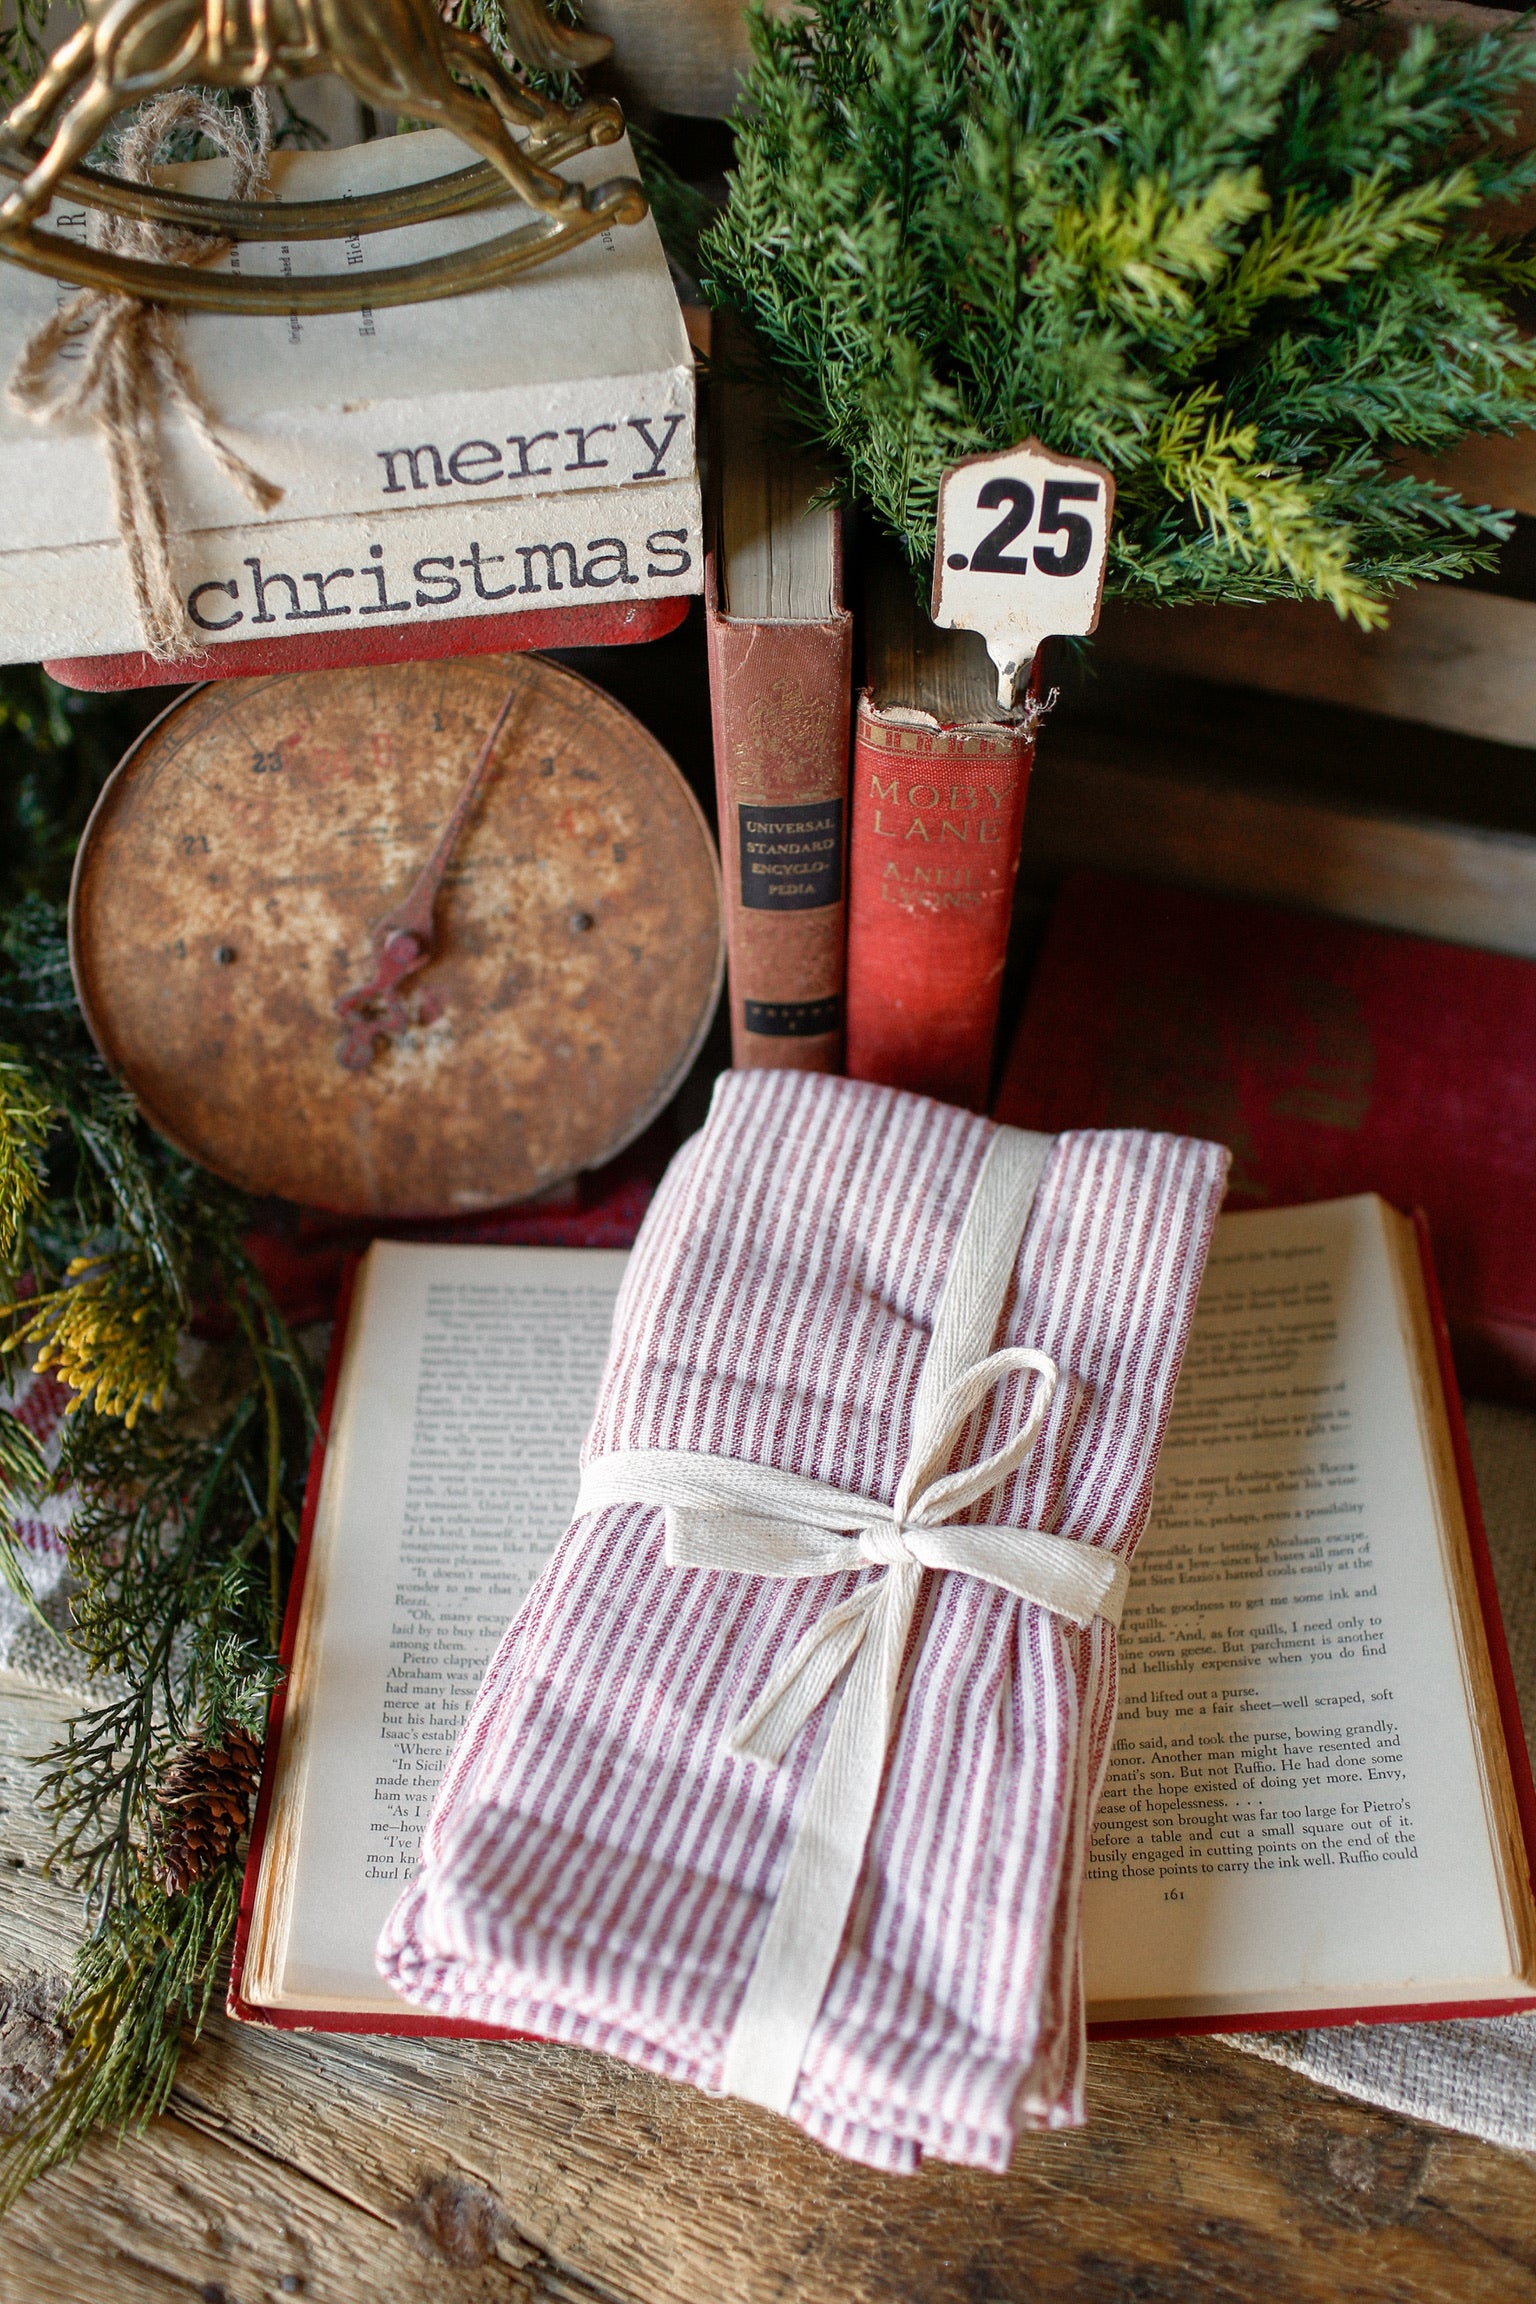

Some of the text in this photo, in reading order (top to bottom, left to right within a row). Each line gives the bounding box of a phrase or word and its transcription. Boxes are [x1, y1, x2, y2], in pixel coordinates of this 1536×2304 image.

[377, 414, 686, 493] merry
[946, 478, 1100, 577] .25
[187, 528, 693, 631] christmas
[252, 752, 283, 773] 23
[869, 775, 1018, 810] MOBY
[746, 819, 835, 834] UNIVERSAL
[873, 809, 1002, 844] LANE
[746, 838, 835, 854] STANDARD
[752, 861, 831, 876] ENCYCLO-
[768, 883, 817, 896] PEDIA
[1137, 1630, 1166, 1644] said.
[1210, 1629, 1223, 1639] as
[1226, 1625, 1245, 1637] for
[1248, 1621, 1287, 1639] quills,
[1291, 1619, 1298, 1632] I
[1303, 1617, 1333, 1631] need
[1336, 1615, 1364, 1630] only
[1369, 1615, 1382, 1626] to
[388, 1637, 467, 1654] among them.
[1148, 1629, 1384, 1659] own geese. But parchment is another
[402, 1651, 439, 1665] Pietro
[1142, 1643, 1387, 1673] hellishly expensive when you do find
[386, 1666, 468, 1681] Abraham was
[385, 1680, 446, 1698] had many
[1122, 1687, 1259, 1704] and lifted out a purse.
[383, 1697, 459, 1710] merce at his
[1116, 1706, 1140, 1720] and
[1145, 1705, 1169, 1720] buy
[1174, 1706, 1194, 1716] me
[1198, 1705, 1206, 1714] a
[1212, 1700, 1234, 1713] fair
[1314, 1690, 1365, 1707] scraped,
[1370, 1688, 1394, 1702] soft
[382, 1711, 425, 1725] but his
[380, 1726, 419, 1740] Isaac's
[1138, 1719, 1398, 1750] said, and took the purse, bowing grandly.
[1151, 1734, 1400, 1764] Another man might have resented and
[1150, 1769, 1175, 1779] son.
[1180, 1764, 1203, 1777] But
[1208, 1763, 1228, 1775] not
[1234, 1759, 1276, 1773] Ruffio.
[1280, 1757, 1302, 1770] He
[1306, 1755, 1330, 1769] had
[1334, 1754, 1366, 1767] done
[1370, 1753, 1403, 1764] some
[375, 1774, 409, 1787] made
[1132, 1769, 1406, 1797] the hope existed of doing yet more. Envy,
[374, 1788, 427, 1802] ham was
[415, 1806, 420, 1817] I
[1128, 1797, 1228, 1814] of hopelessness.
[1092, 1798, 1411, 1833] youngest son brought was far too large for Pietro's
[1091, 1815, 1414, 1847] before a table and cut a small square out of it.
[1089, 1831, 1415, 1864] busily engaged in cutting points on the end of the
[366, 1854, 394, 1864] mon
[1121, 1864, 1155, 1877] those
[1158, 1862, 1198, 1878] points
[1201, 1861, 1214, 1872] to
[1216, 1860, 1249, 1873] carry
[1253, 1855, 1275, 1869] the
[1278, 1853, 1300, 1867] ink
[1302, 1851, 1335, 1865] well.
[1338, 1849, 1379, 1863] Ruffio
[1382, 1846, 1418, 1860] could
[364, 1866, 398, 1880] churl
[1163, 1888, 1185, 1901] 161
